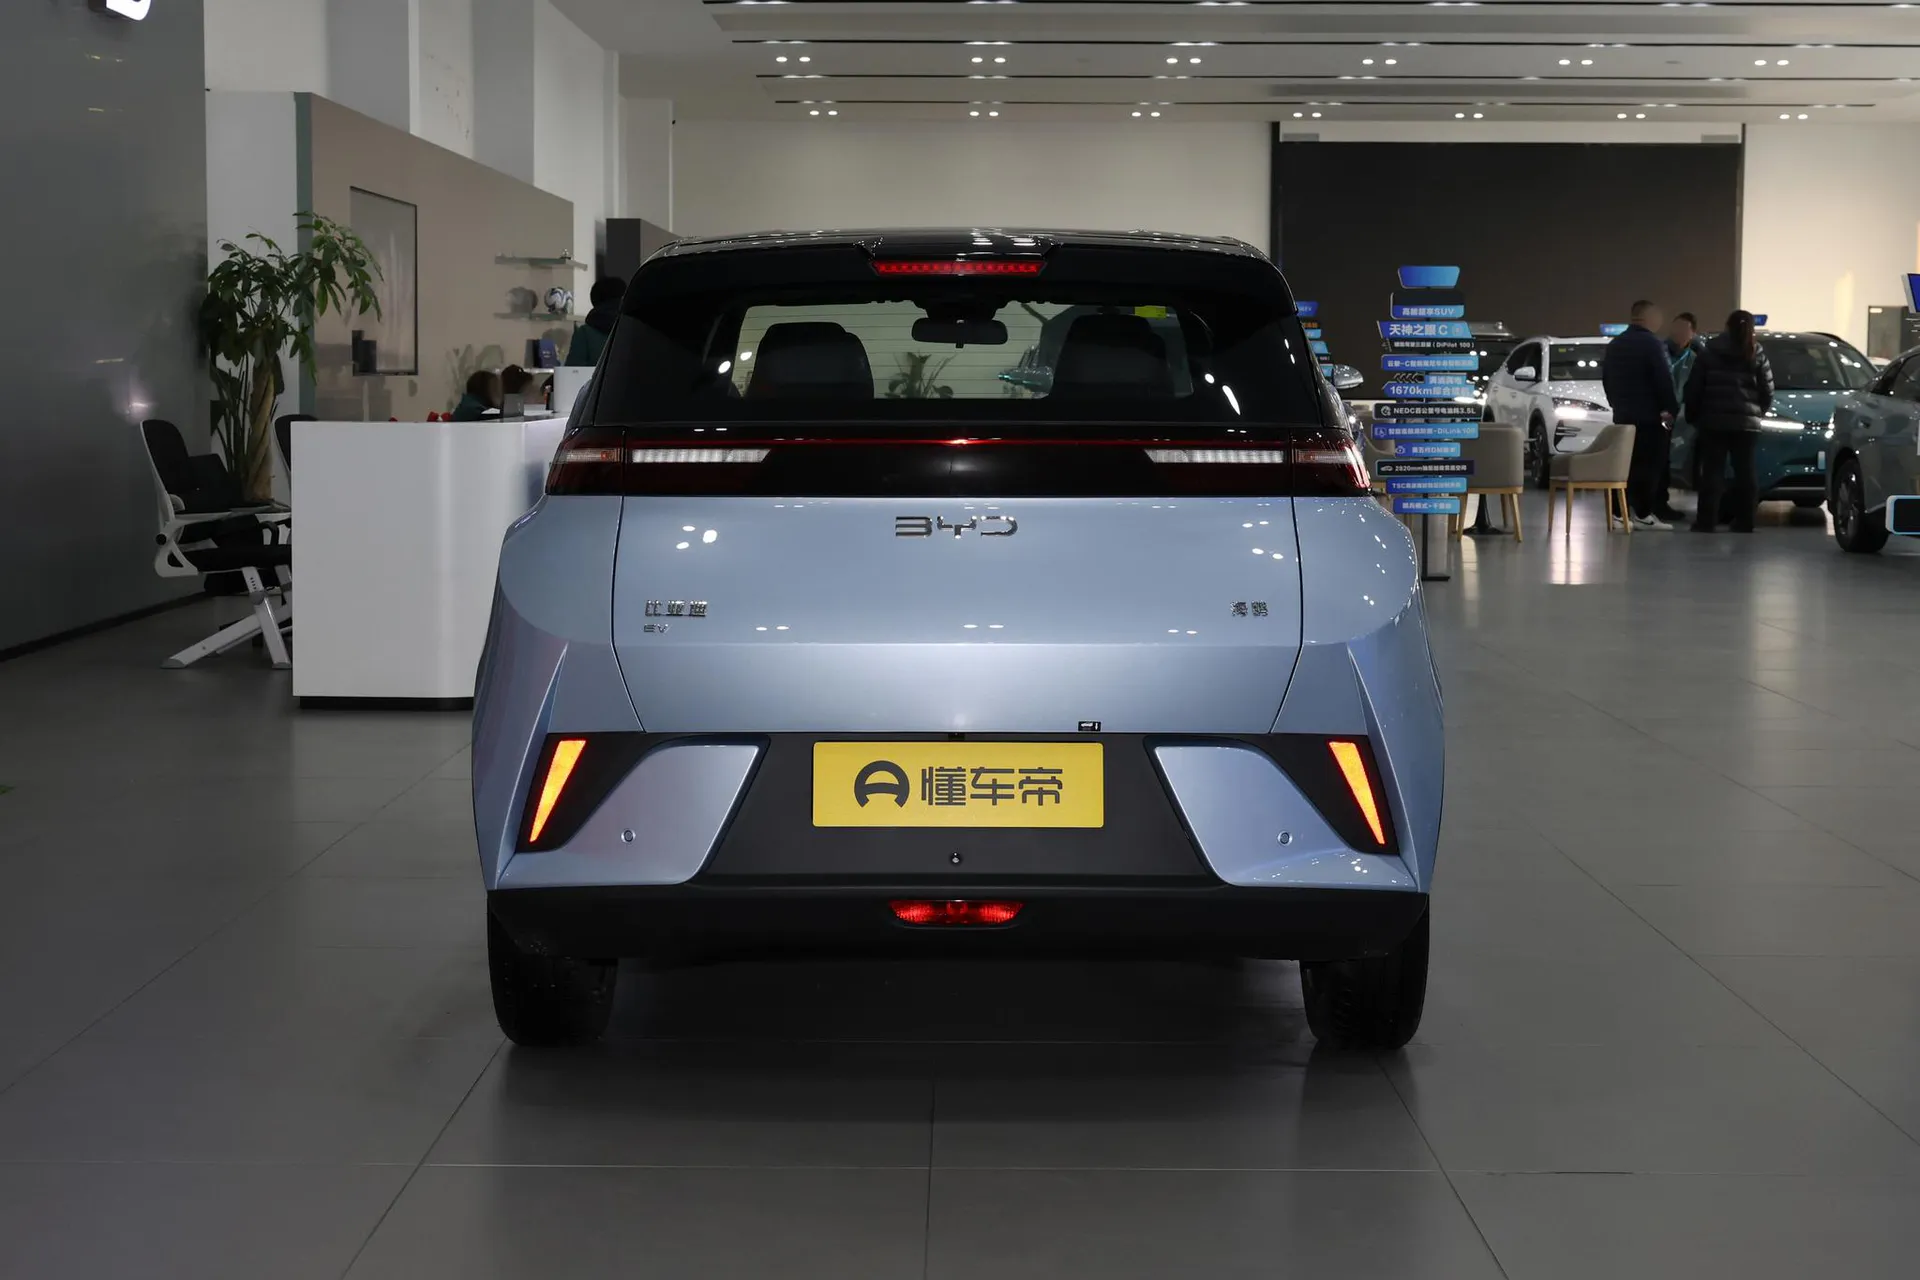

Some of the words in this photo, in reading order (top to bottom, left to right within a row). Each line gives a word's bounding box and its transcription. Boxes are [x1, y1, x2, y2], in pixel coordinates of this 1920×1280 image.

[895, 515, 1019, 540] BYD
[645, 599, 708, 617] 比亚迪
[643, 623, 669, 633] EV
[921, 766, 1063, 806] 懂车帝
